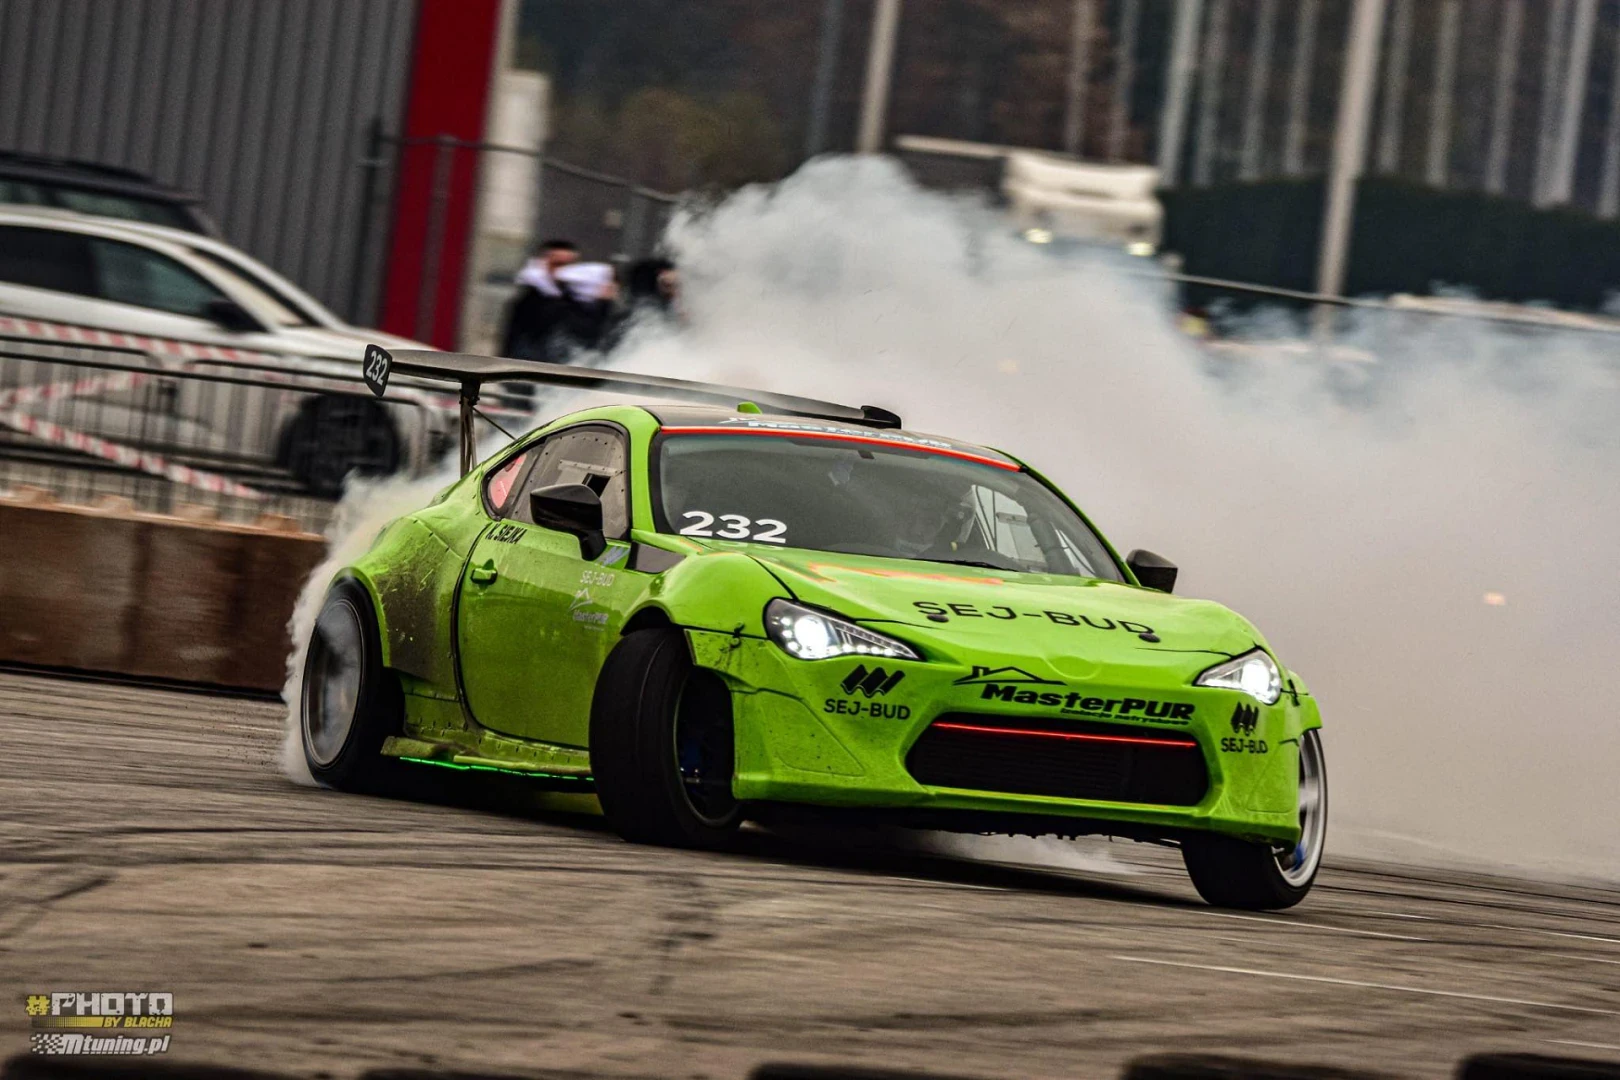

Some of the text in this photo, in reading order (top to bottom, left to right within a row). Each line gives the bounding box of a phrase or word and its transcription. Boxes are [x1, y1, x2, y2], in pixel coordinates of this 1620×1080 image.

[366, 350, 388, 386] 232
[680, 511, 787, 544] 232
[913, 601, 1155, 634] SEJ-BUD
[823, 698, 911, 720] SEJ-BUD
[980, 682, 1196, 720] MasterPUR
